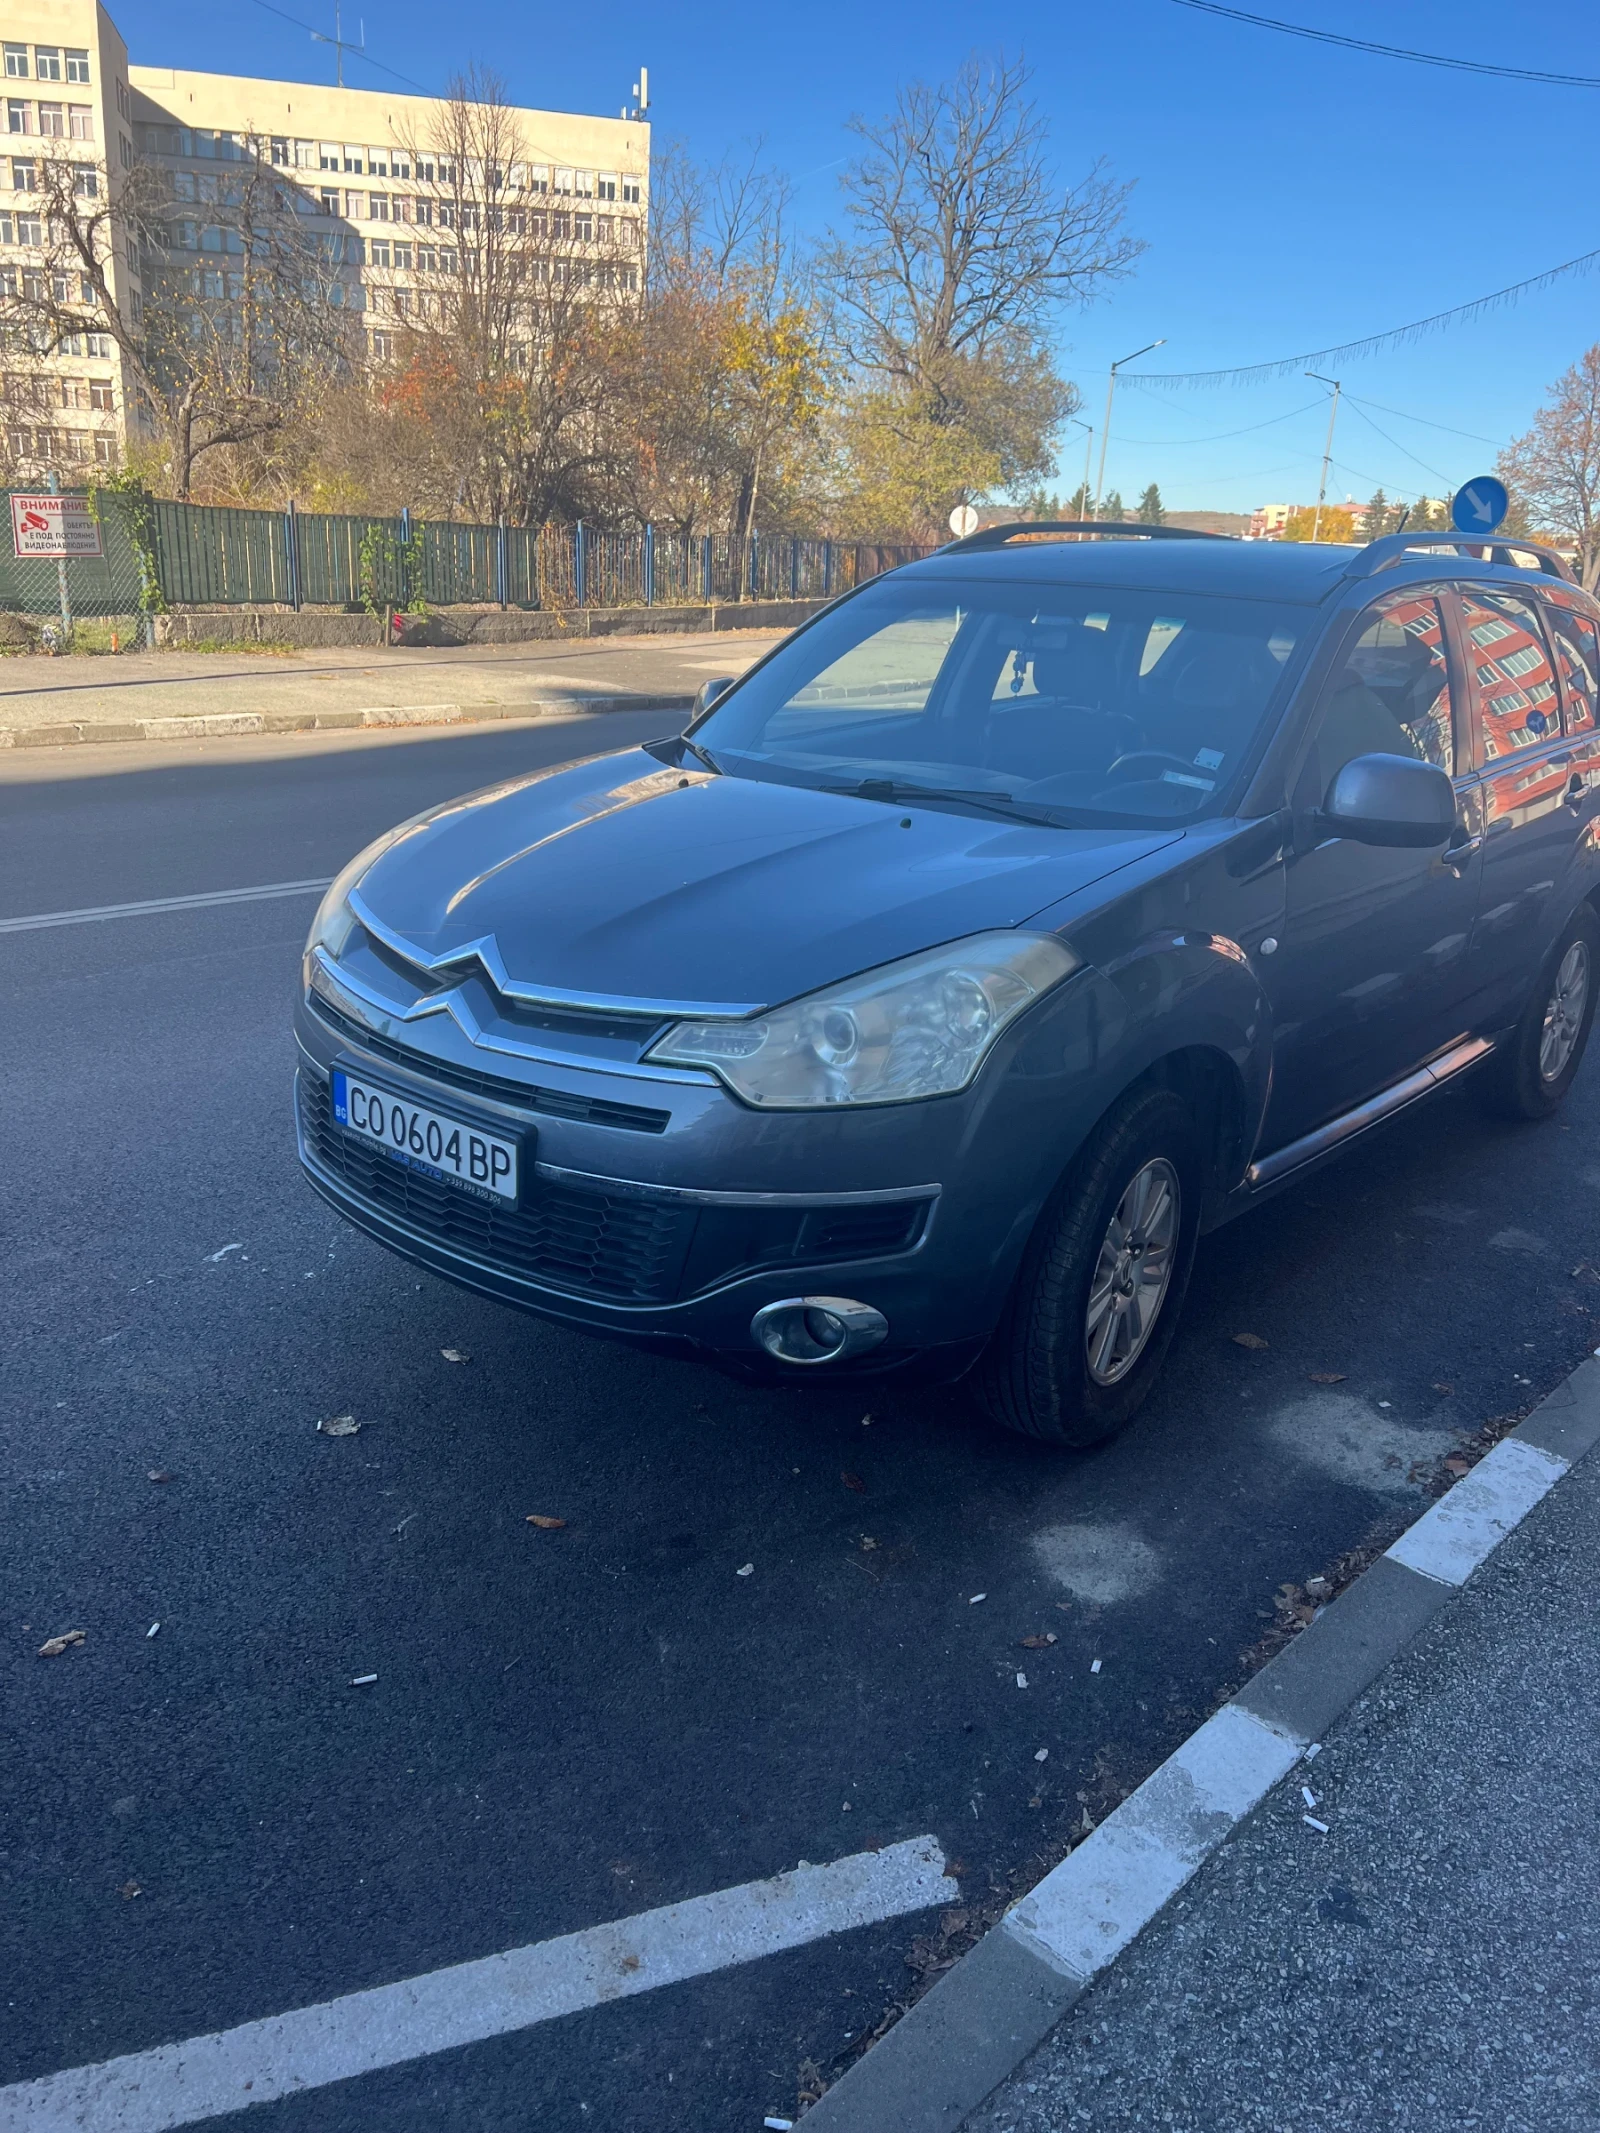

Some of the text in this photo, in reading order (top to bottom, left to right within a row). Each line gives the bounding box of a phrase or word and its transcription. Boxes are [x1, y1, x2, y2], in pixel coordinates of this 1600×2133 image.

[20, 500, 88, 511] ВНИМАНИЕ
[29, 532, 95, 541] Е ПОД ПОСТОЯННО
[25, 541, 97, 550] ВИДЕОНАБЛЮДЕНИЕ
[335, 1104, 347, 1119] BG
[351, 1087, 510, 1187] CO 0604 BP
[411, 1160, 443, 1180] AUTO
